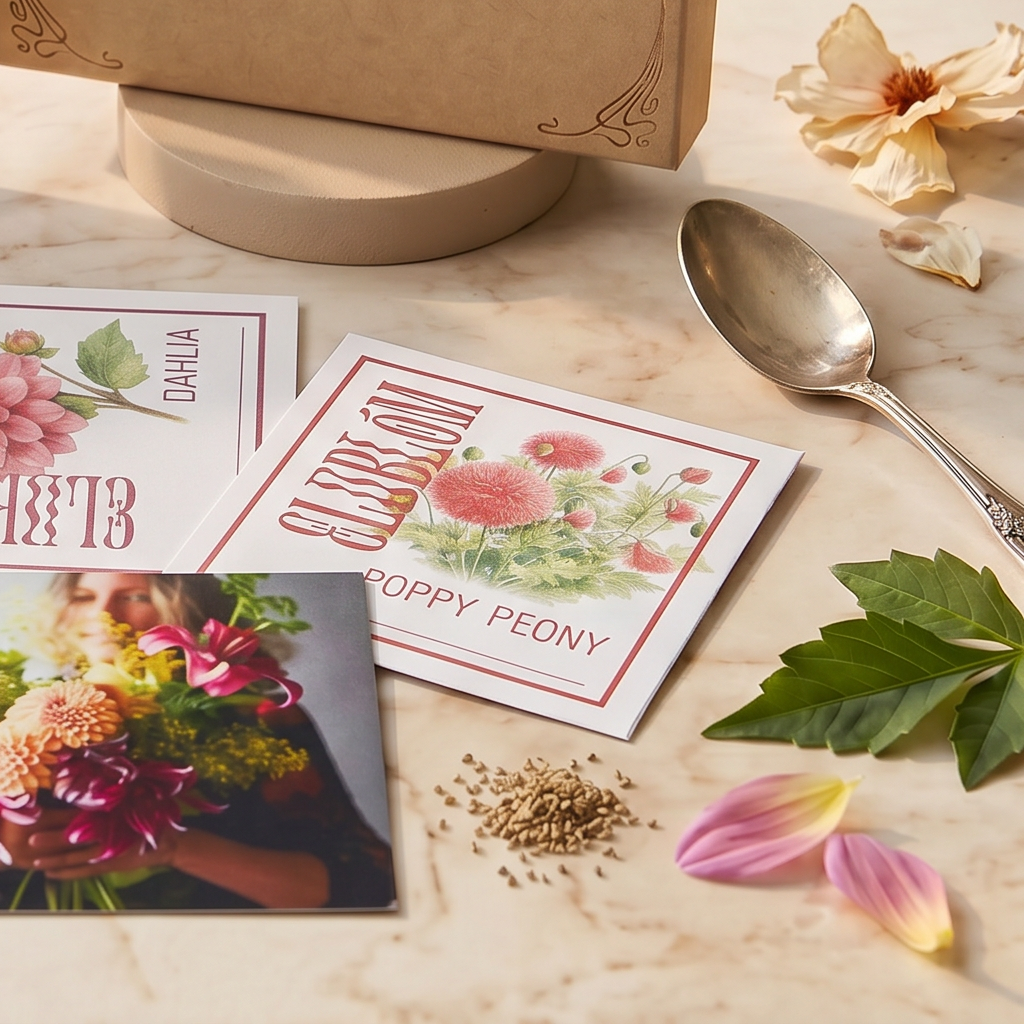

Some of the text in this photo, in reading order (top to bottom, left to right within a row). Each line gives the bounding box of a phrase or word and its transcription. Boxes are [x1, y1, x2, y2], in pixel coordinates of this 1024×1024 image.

[162, 328, 200, 403] DAHLIA
[363, 567, 611, 657] POPPY PEONY
